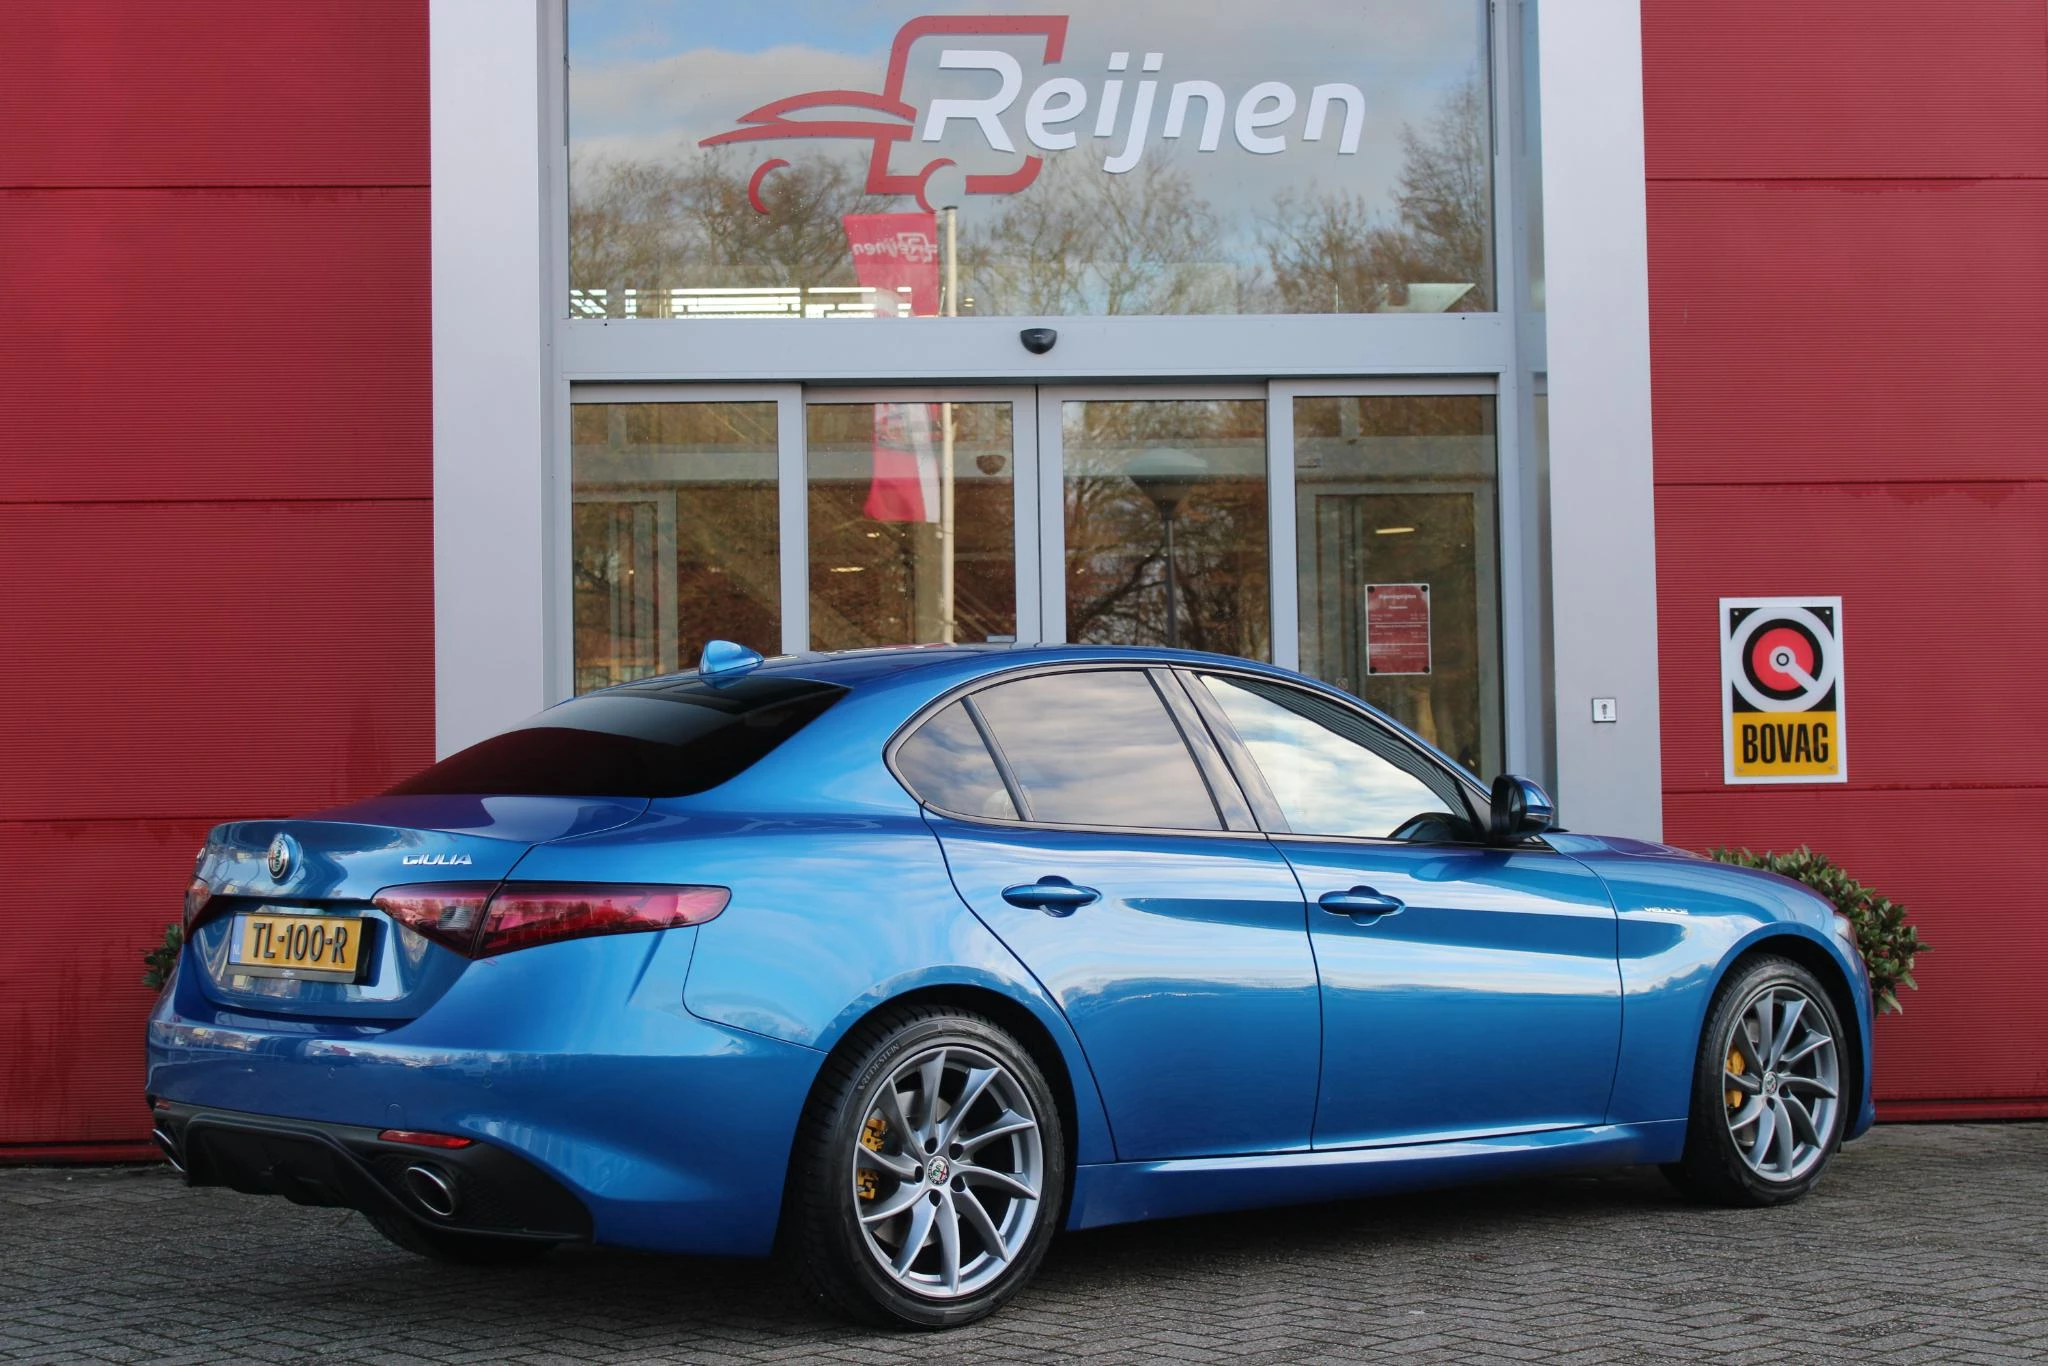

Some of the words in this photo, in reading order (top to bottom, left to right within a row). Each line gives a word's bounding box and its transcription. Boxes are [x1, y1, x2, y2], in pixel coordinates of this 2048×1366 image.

[922, 49, 1366, 174] Reijnen
[1742, 722, 1829, 765] BOVAG
[402, 853, 473, 865] GIULIA
[252, 922, 348, 964] TL-100-R
[857, 1042, 901, 1090] VREDESTEIN
